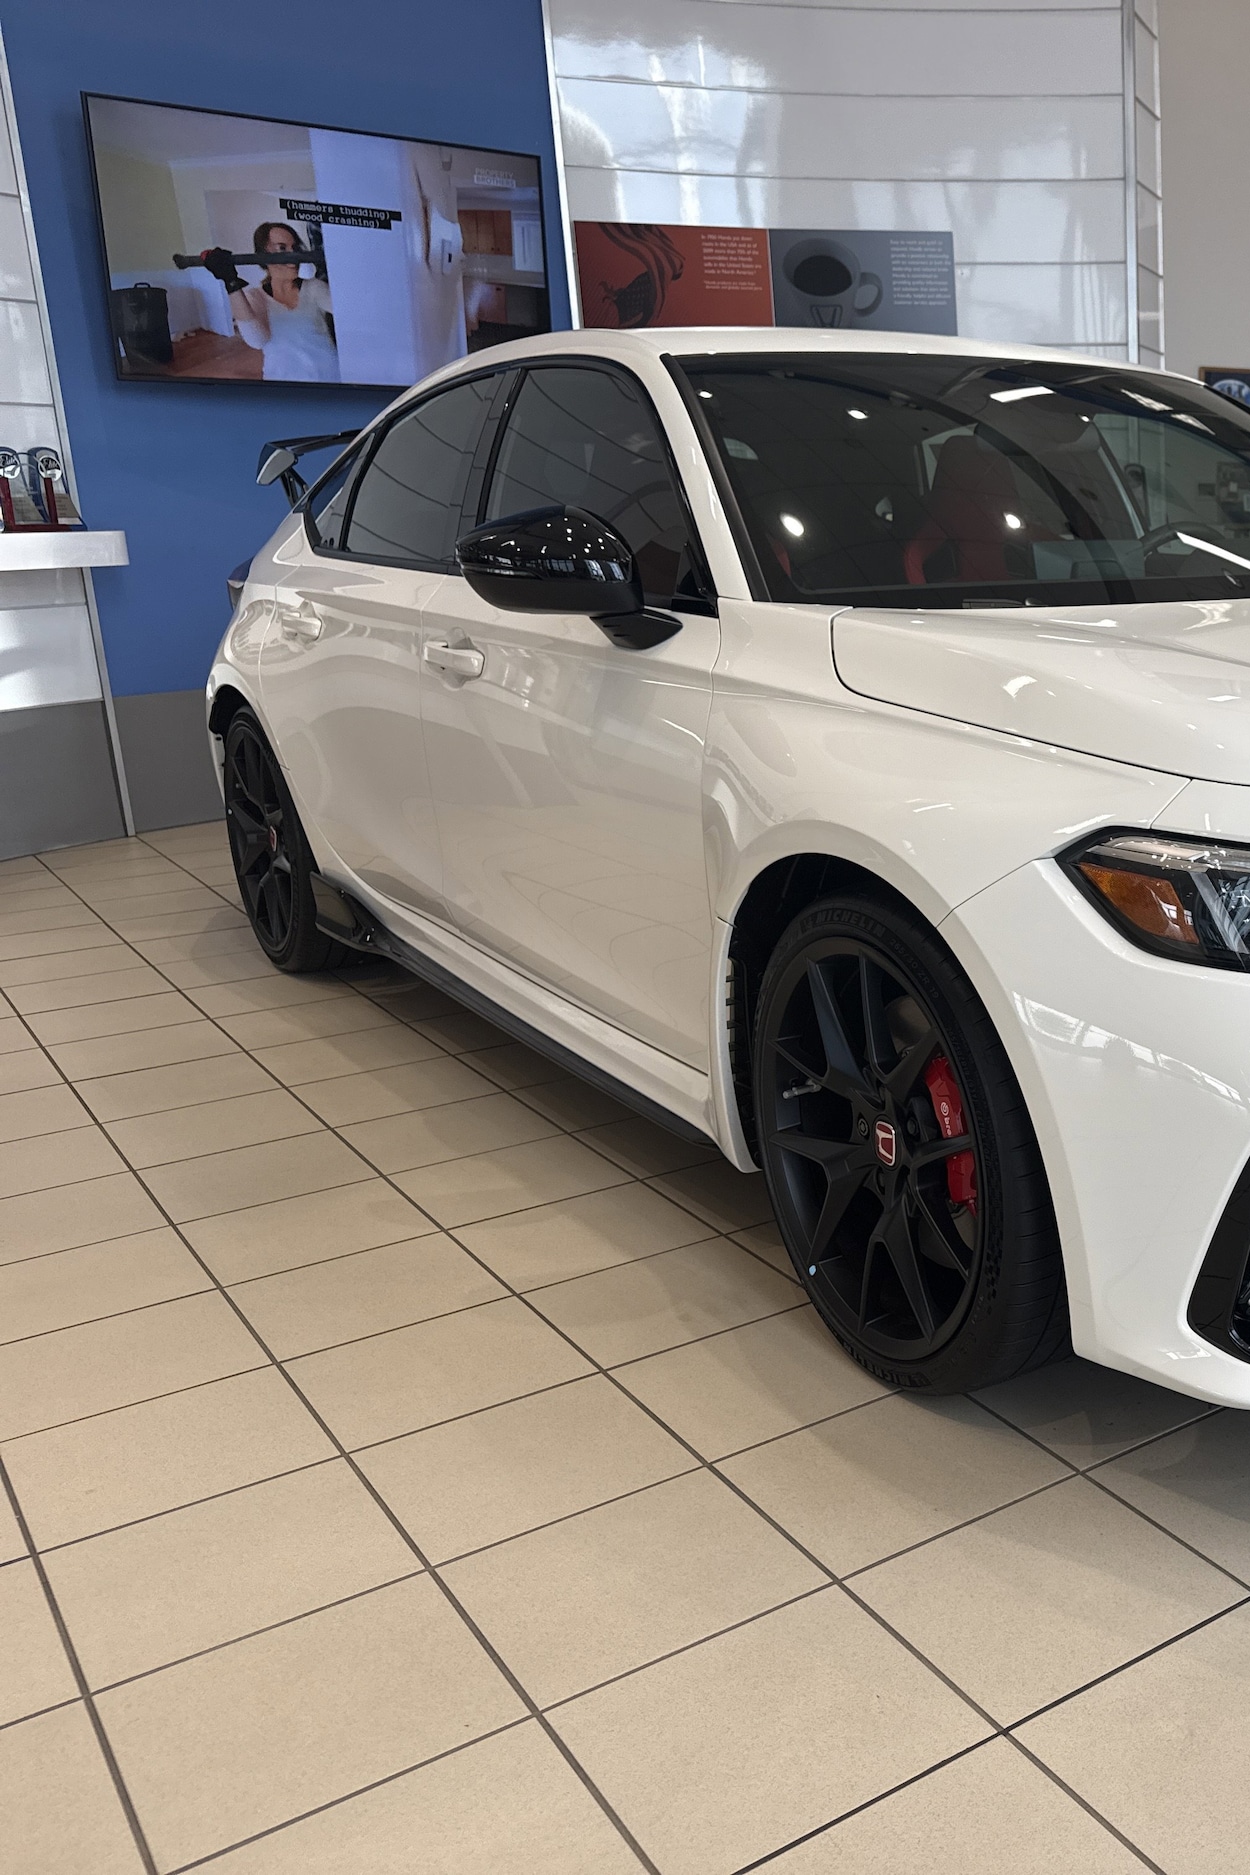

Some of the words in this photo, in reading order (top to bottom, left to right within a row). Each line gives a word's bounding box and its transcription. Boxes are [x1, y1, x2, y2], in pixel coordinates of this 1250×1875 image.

[286, 200, 334, 214] (hammers
[339, 206, 390, 220] thudding)
[293, 211, 323, 222] (wood
[328, 215, 380, 229] crashing)
[815, 908, 886, 938] MICHELIN
